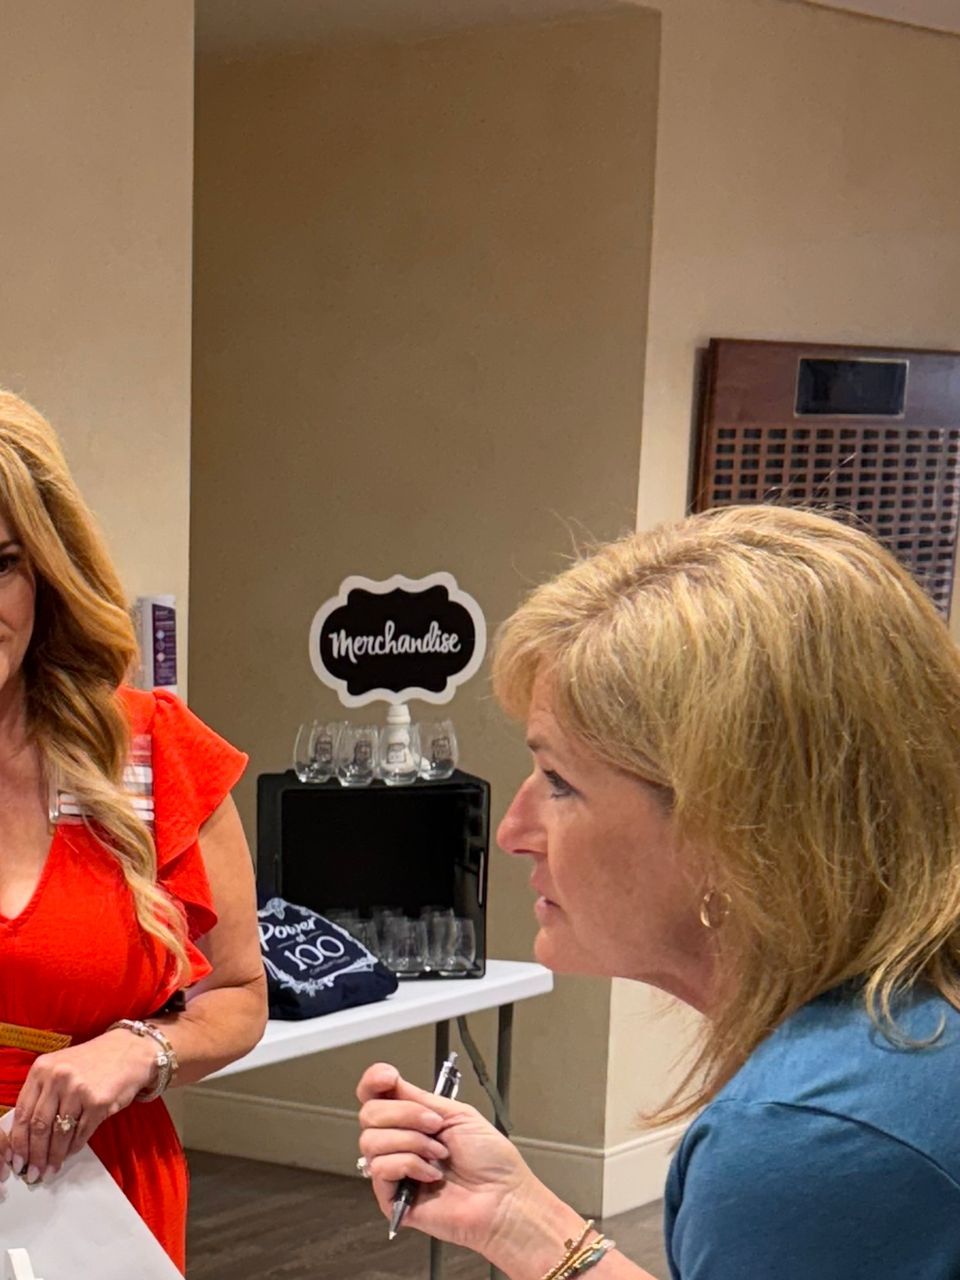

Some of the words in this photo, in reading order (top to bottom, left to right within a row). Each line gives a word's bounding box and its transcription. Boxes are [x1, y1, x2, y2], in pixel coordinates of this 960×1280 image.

[328, 620, 461, 664] Merchandise
[258, 917, 316, 951] Power
[284, 936, 344, 971] 100
